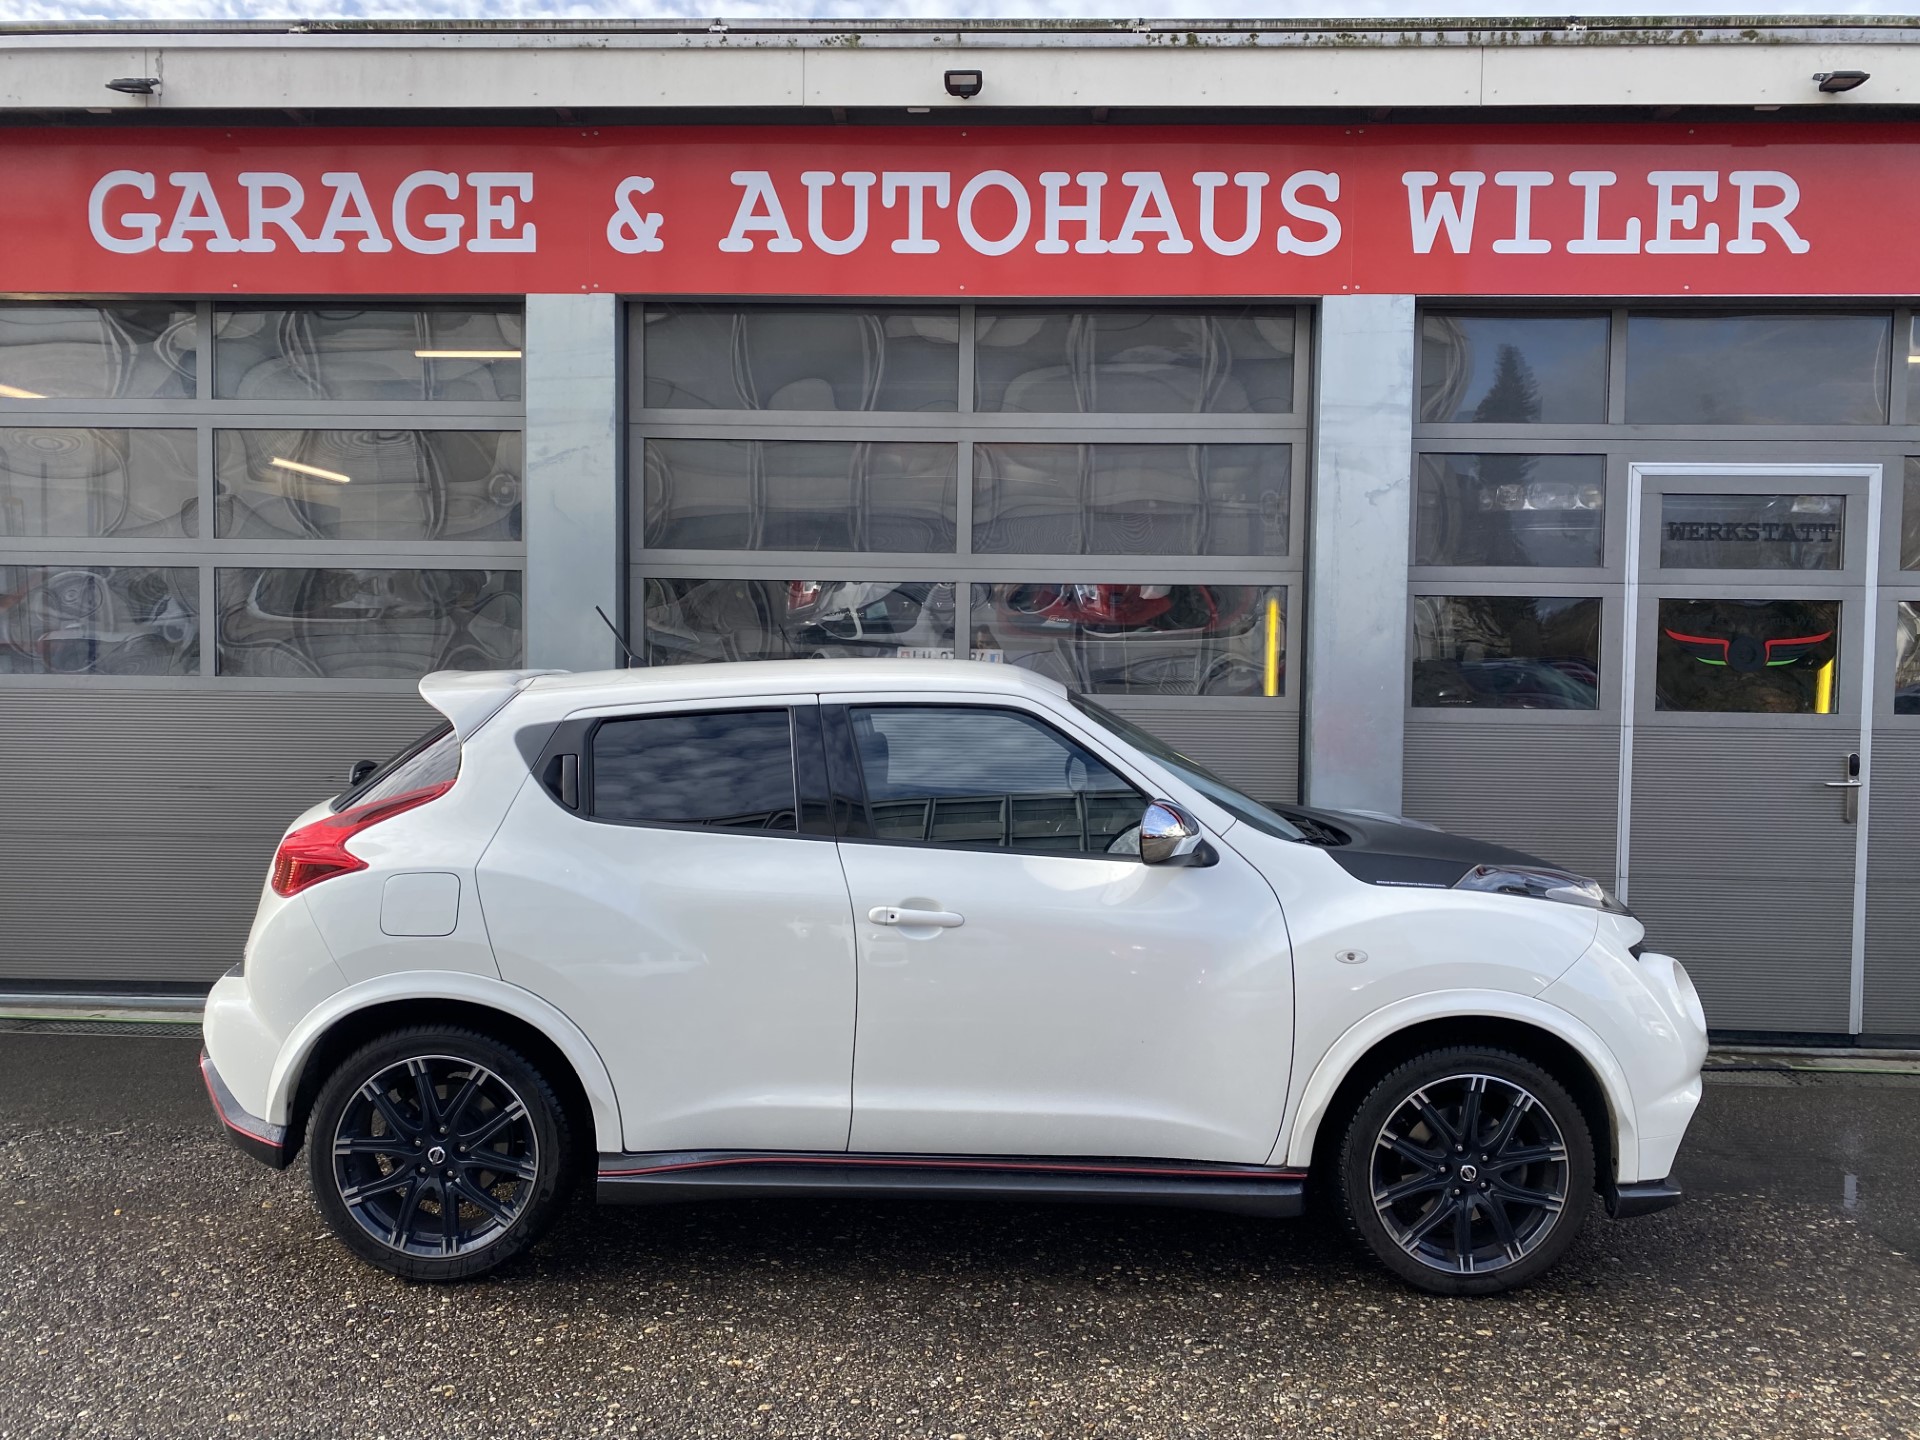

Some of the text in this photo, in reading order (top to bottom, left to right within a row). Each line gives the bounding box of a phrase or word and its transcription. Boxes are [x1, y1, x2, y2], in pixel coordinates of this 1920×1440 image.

[88, 169, 1811, 258] GARAGE & AUTOHAUS WILER
[1669, 523, 1836, 542] WERKSTATT
